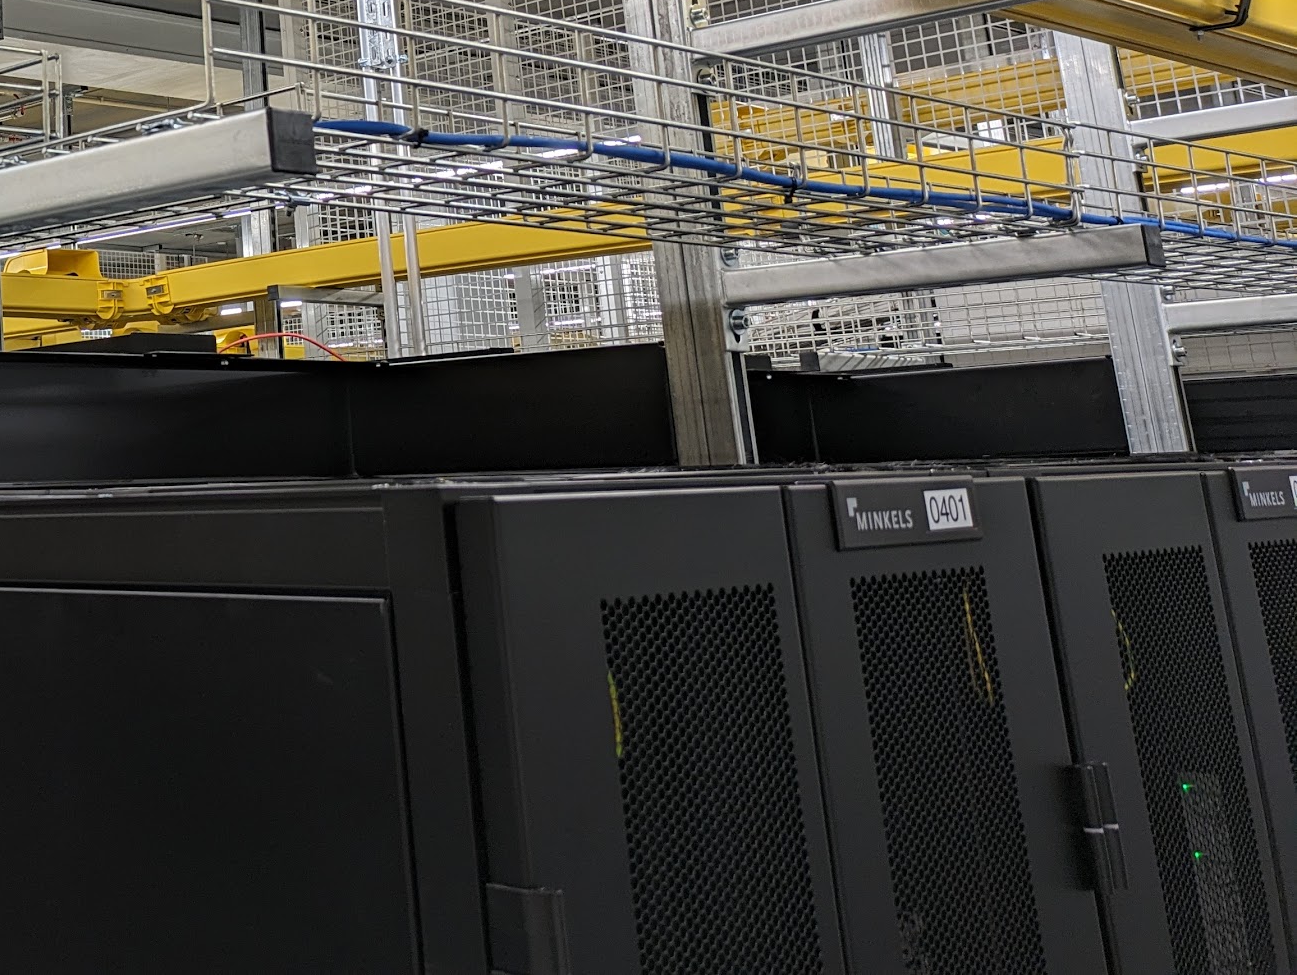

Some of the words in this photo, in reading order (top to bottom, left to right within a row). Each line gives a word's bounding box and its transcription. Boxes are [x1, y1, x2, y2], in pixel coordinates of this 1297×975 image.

[929, 495, 967, 523] 0401
[1249, 491, 1285, 506] MINKELS
[856, 510, 913, 531] MINKELS
